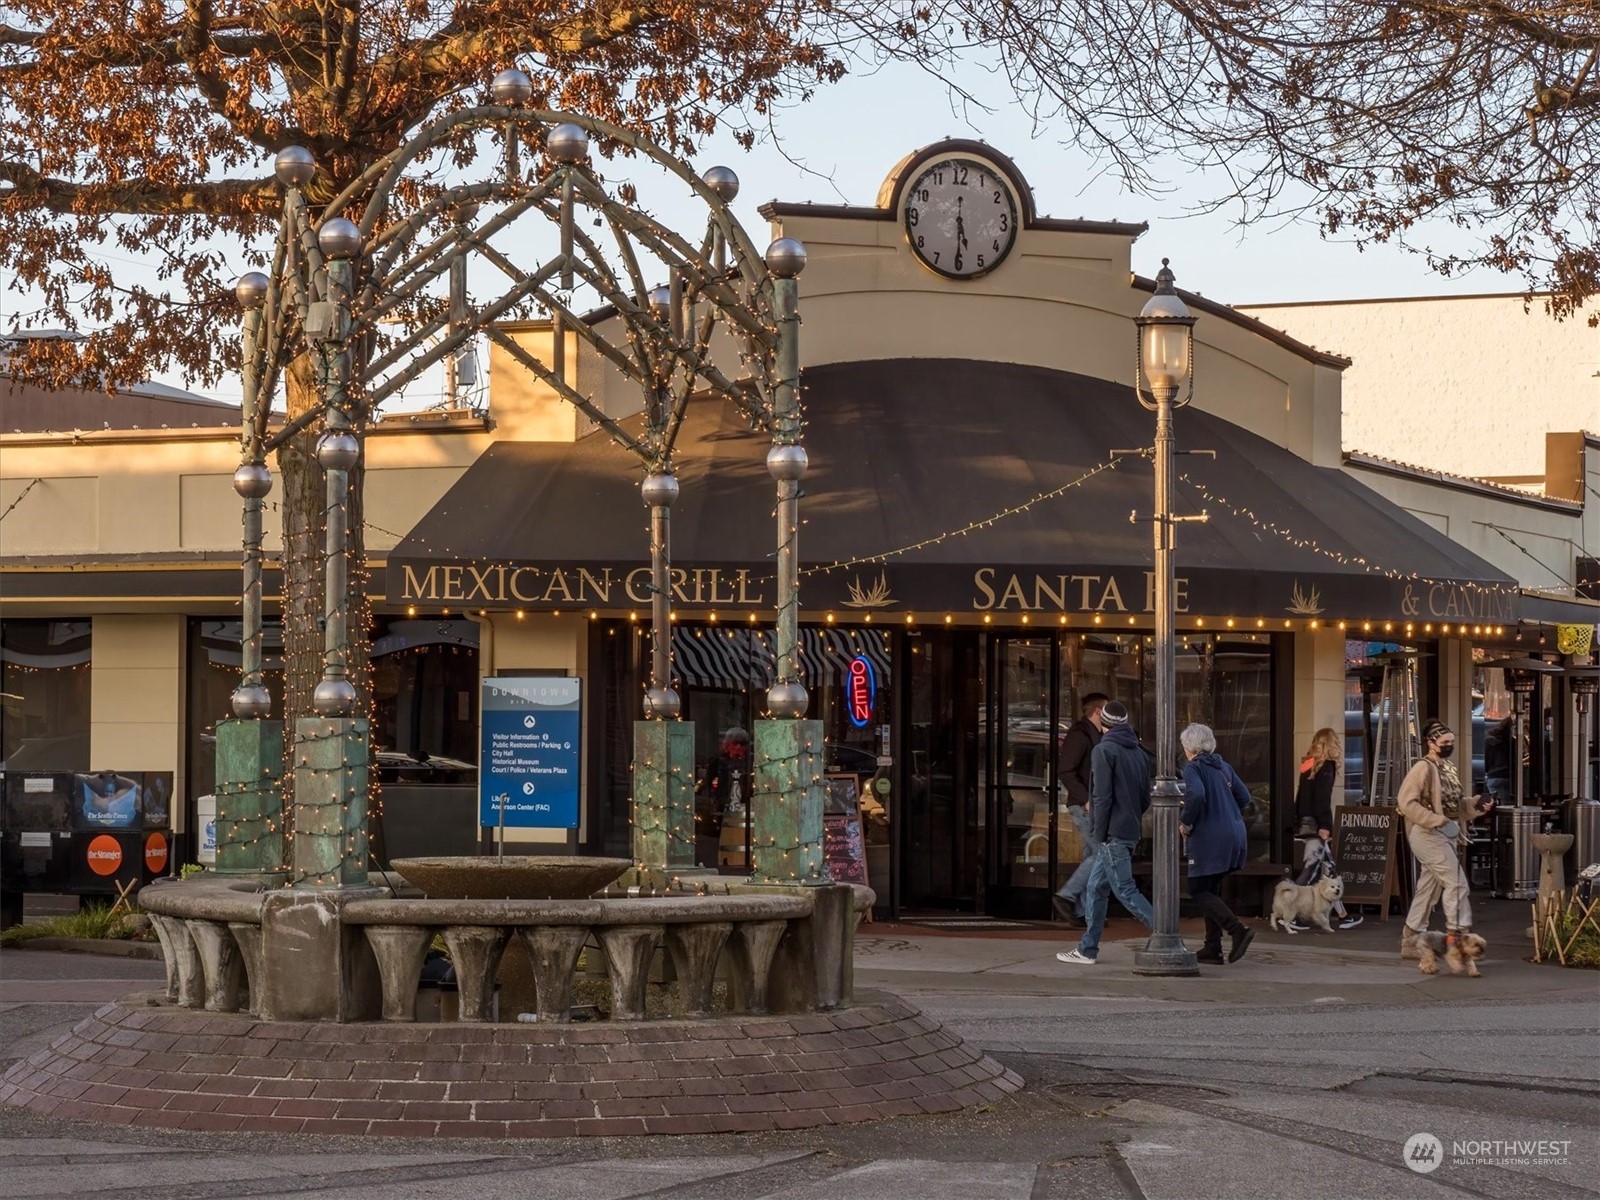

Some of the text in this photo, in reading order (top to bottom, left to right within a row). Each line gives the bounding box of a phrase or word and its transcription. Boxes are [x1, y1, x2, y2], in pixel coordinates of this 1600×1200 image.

[933, 172, 942, 185] 11
[953, 167, 968, 185] 12
[979, 174, 984, 187] 1
[917, 189, 929, 202] 10
[994, 191, 1001, 203] 2
[910, 208, 919, 226] 9
[999, 214, 1008, 232] 3
[917, 235, 924, 248] 8
[992, 239, 999, 252] 4
[933, 252, 940, 265] 7
[954, 252, 963, 271] 6
[977, 254, 984, 267] 5
[401, 564, 763, 604] MEXICAN GRILL
[973, 567, 1128, 611] SANTA
[1401, 584, 1515, 619] & CANTINA
[492, 687, 569, 697] DOWNTOWN
[851, 659, 869, 720] OPEN
[541, 742, 561, 750] Parking
[530, 766, 552, 774] Veterans
[491, 795, 510, 803] Libry
[535, 804, 550, 812] (FAC)
[1341, 813, 1390, 828] BIENVENIDOS
